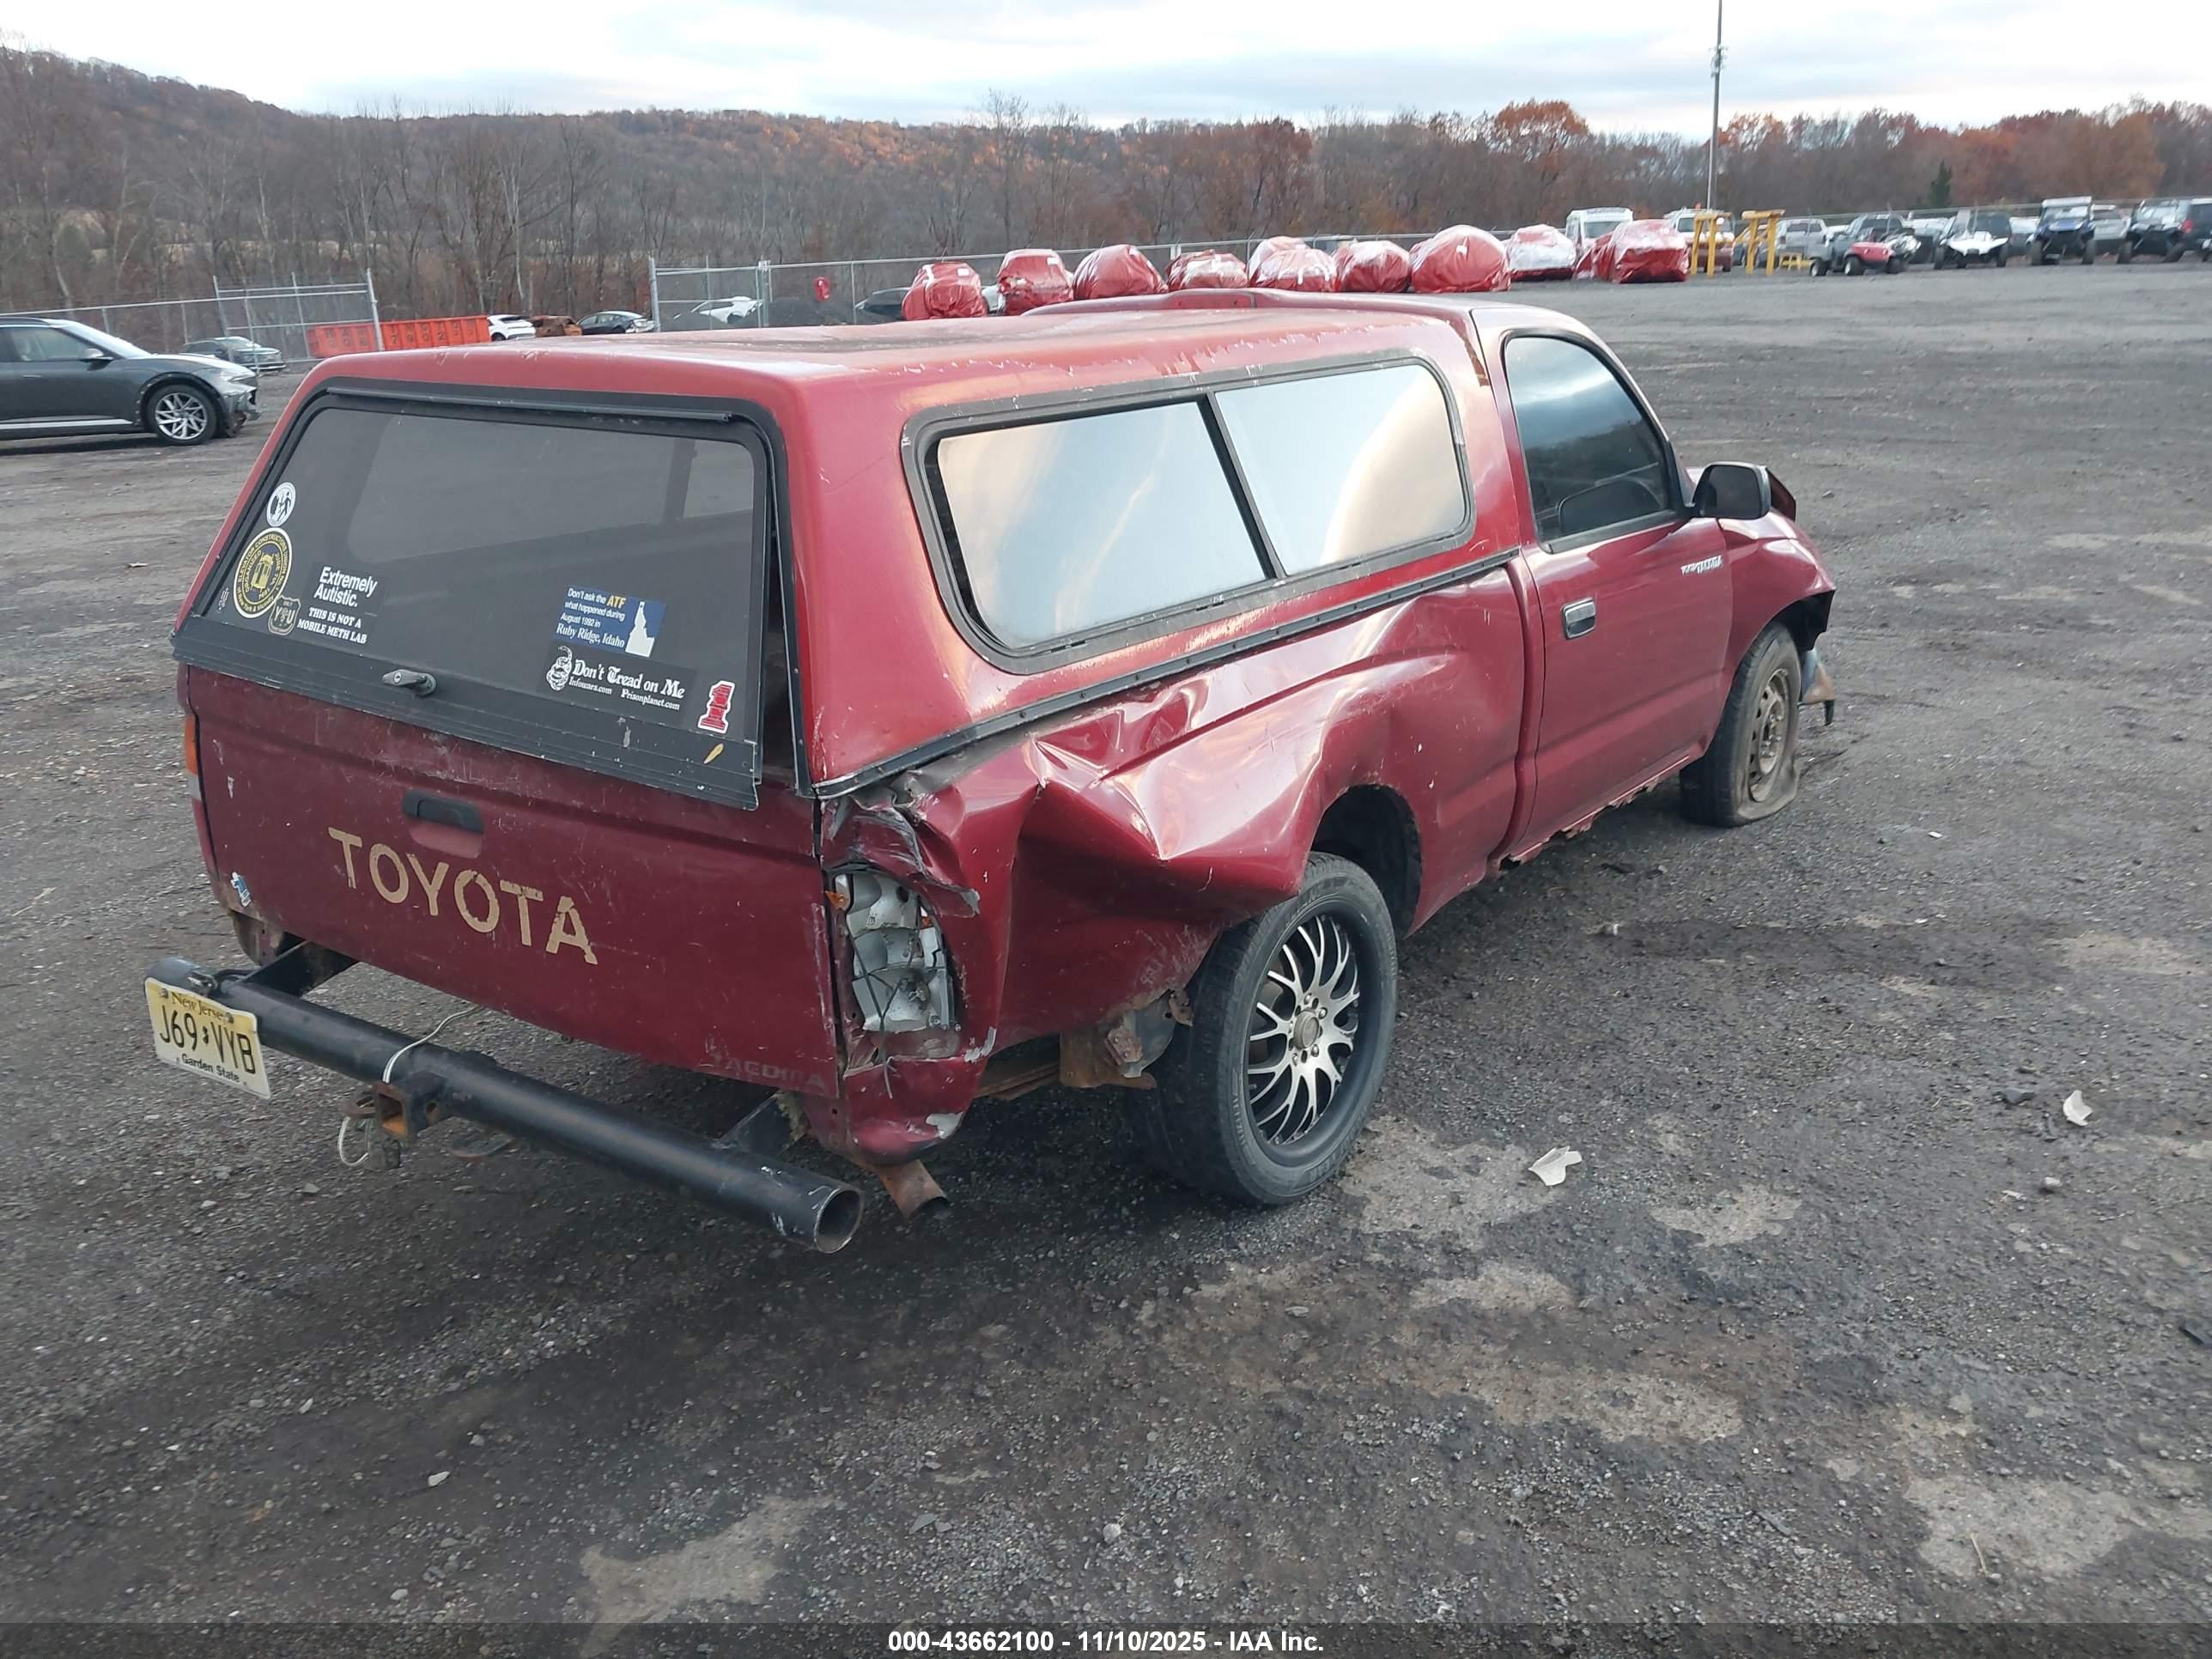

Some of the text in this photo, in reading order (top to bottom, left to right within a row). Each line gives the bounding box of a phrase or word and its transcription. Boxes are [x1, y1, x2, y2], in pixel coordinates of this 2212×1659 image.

[313, 583, 358, 607] Autistic.
[319, 567, 378, 598] Extremely
[568, 588, 627, 609] Don't ask the ATF
[309, 607, 362, 629] THIS IS NOT A
[560, 612, 580, 623] August
[581, 617, 595, 627] 1992
[564, 601, 625, 622] what happened during
[297, 618, 368, 644] MOBILE METH LAB
[556, 623, 625, 648] Ruby Ridge, Idaho
[572, 659, 685, 699] Don't Tread on Me
[568, 677, 681, 711] Infowars.com Prisonplanet.com
[328, 827, 599, 965] TOYOTA
[172, 992, 197, 1011] New
[181, 1053, 240, 1083] Garden State
